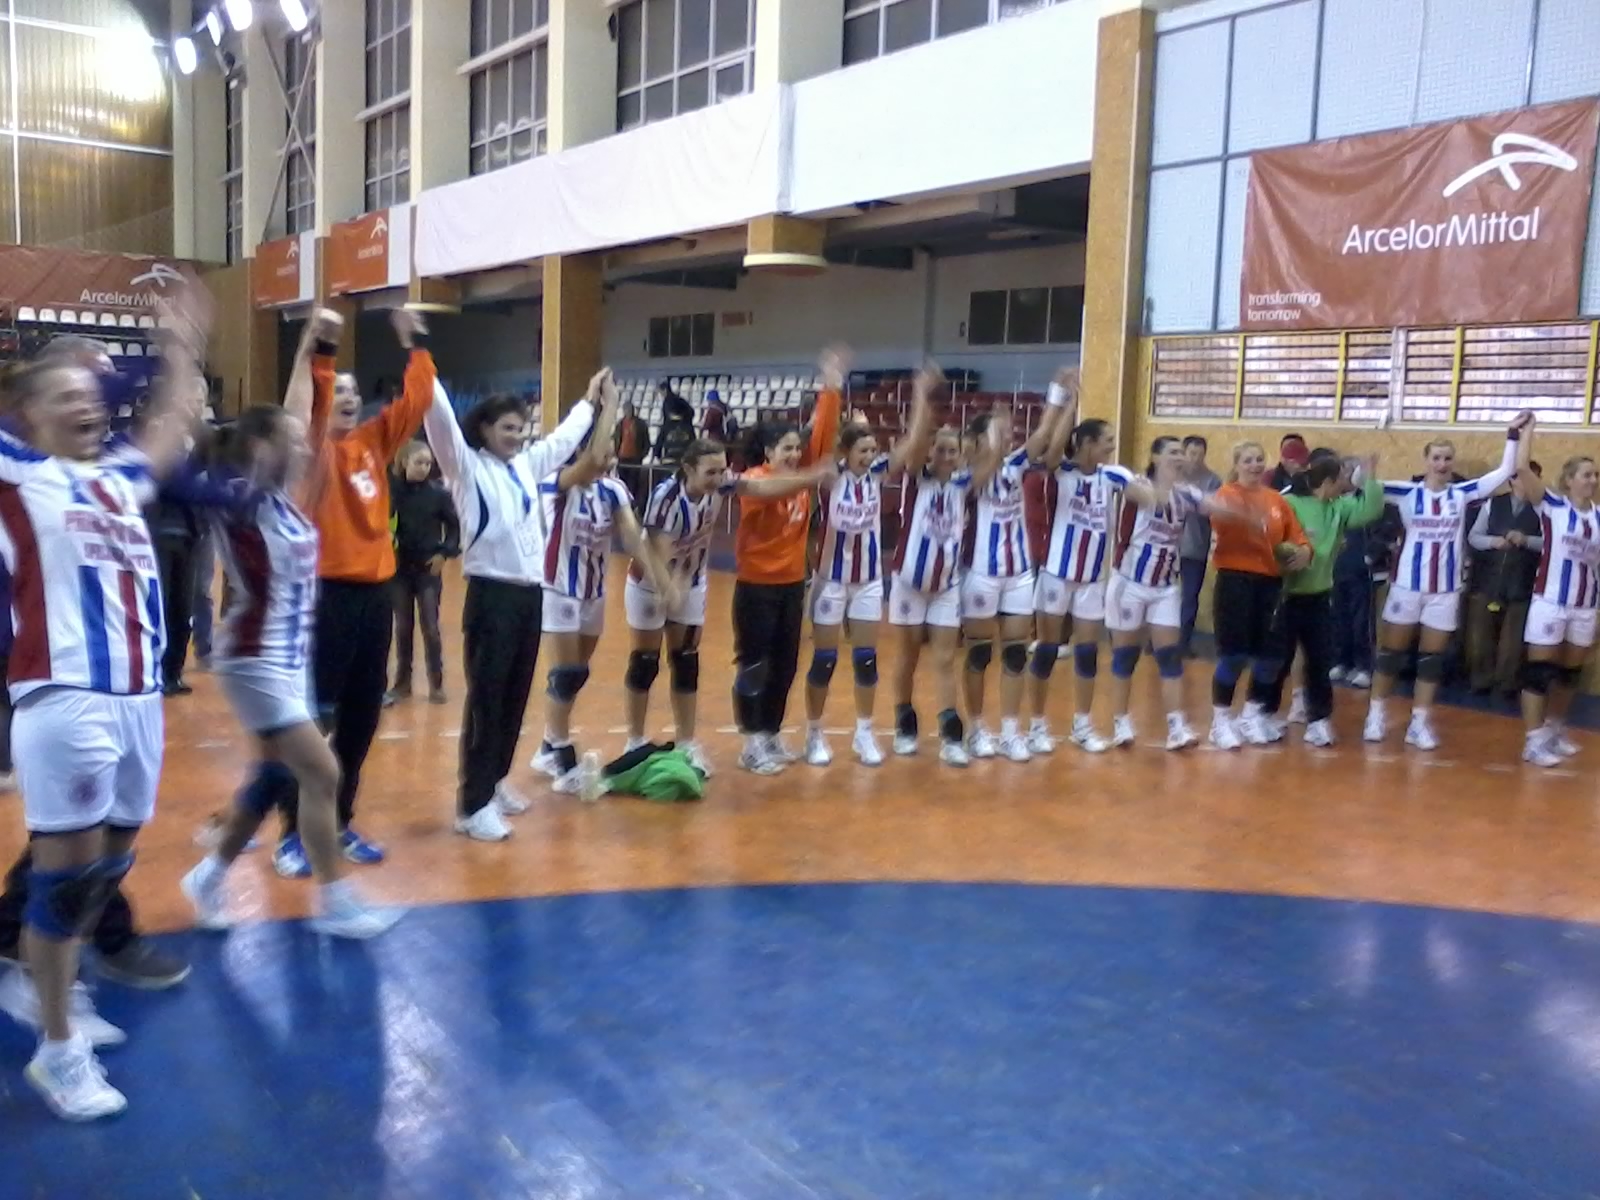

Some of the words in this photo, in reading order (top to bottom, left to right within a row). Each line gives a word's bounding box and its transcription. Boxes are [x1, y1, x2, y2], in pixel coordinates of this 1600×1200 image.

[1341, 206, 1541, 255] ArcelorMittal
[1248, 289, 1322, 308] transforming
[1247, 308, 1301, 322] tomorrow
